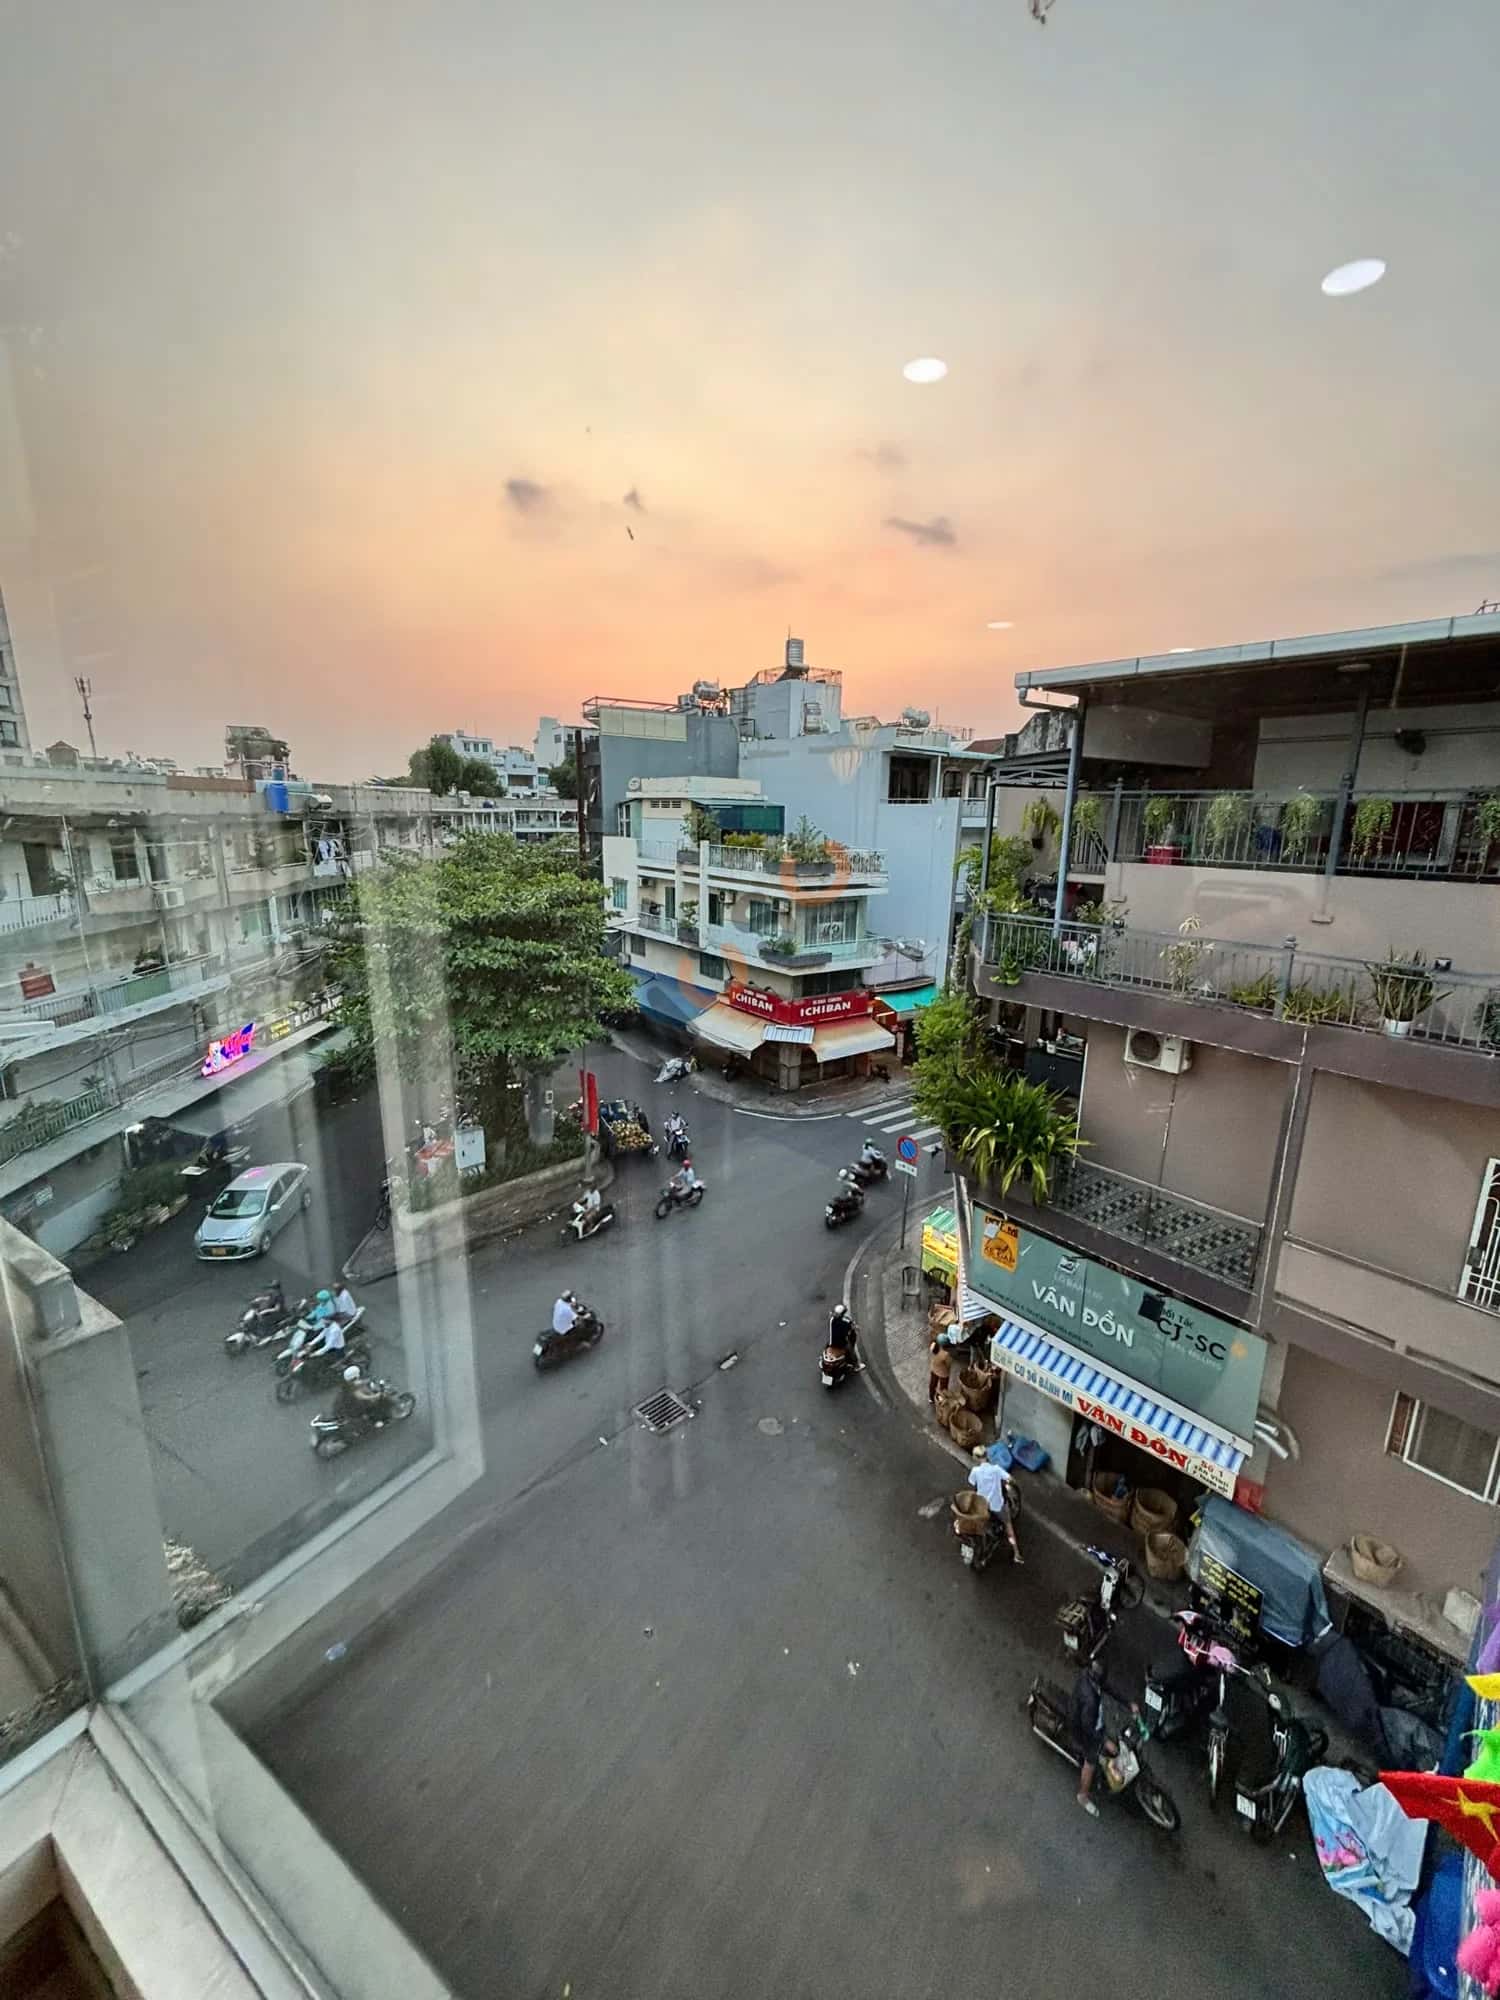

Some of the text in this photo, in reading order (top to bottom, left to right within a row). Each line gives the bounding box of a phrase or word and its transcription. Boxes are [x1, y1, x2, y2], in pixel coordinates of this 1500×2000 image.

[732, 991, 773, 1012] ICHIBAN
[800, 1001, 851, 1017] ICHIBAN
[1032, 1280, 1076, 1317] VÂN
[1082, 1309, 1134, 1348] ĐỒN
[1156, 1317, 1227, 1361] CJ-SC
[1077, 1397, 1124, 1433] VÂN
[1130, 1426, 1188, 1468] ĐỒN
